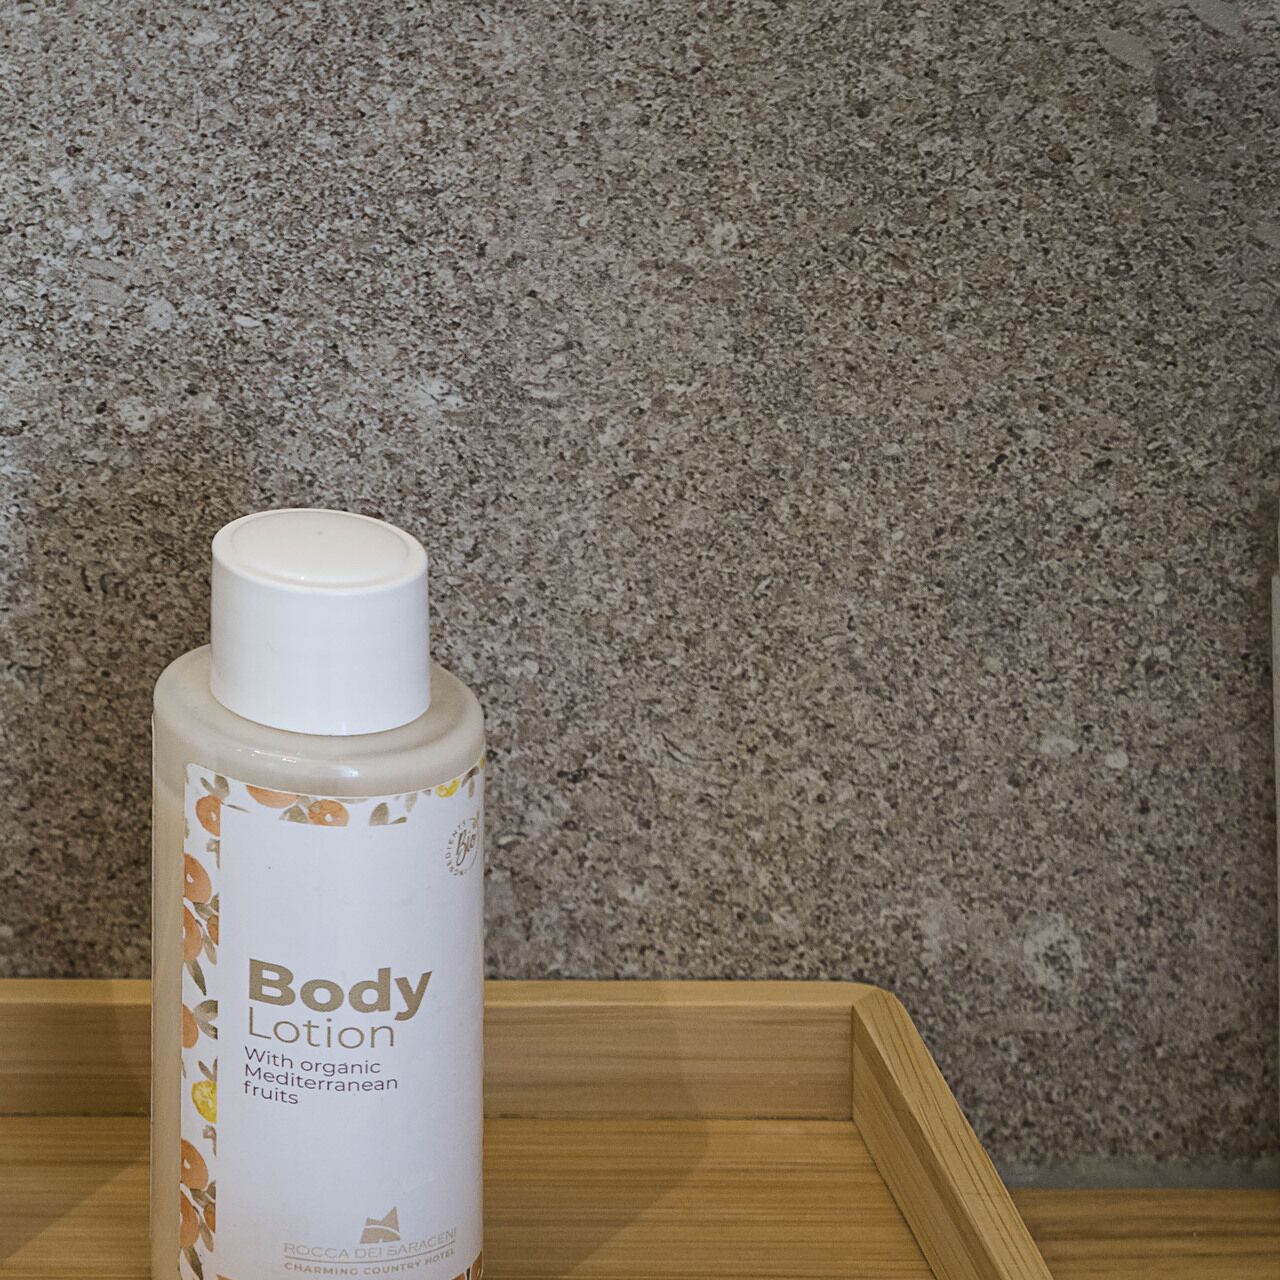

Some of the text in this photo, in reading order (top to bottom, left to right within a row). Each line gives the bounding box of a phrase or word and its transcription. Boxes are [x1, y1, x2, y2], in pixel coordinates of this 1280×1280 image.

[248, 958, 433, 1021] Body
[248, 1006, 395, 1049] Lotion
[244, 1045, 381, 1078] With organic
[243, 1081, 299, 1105] fruits
[244, 1064, 398, 1093] Mediterranean
[283, 1227, 457, 1259] ROCCA DEI SARACENI
[284, 1248, 455, 1276] CHARMING COUNTRY HOTEL
